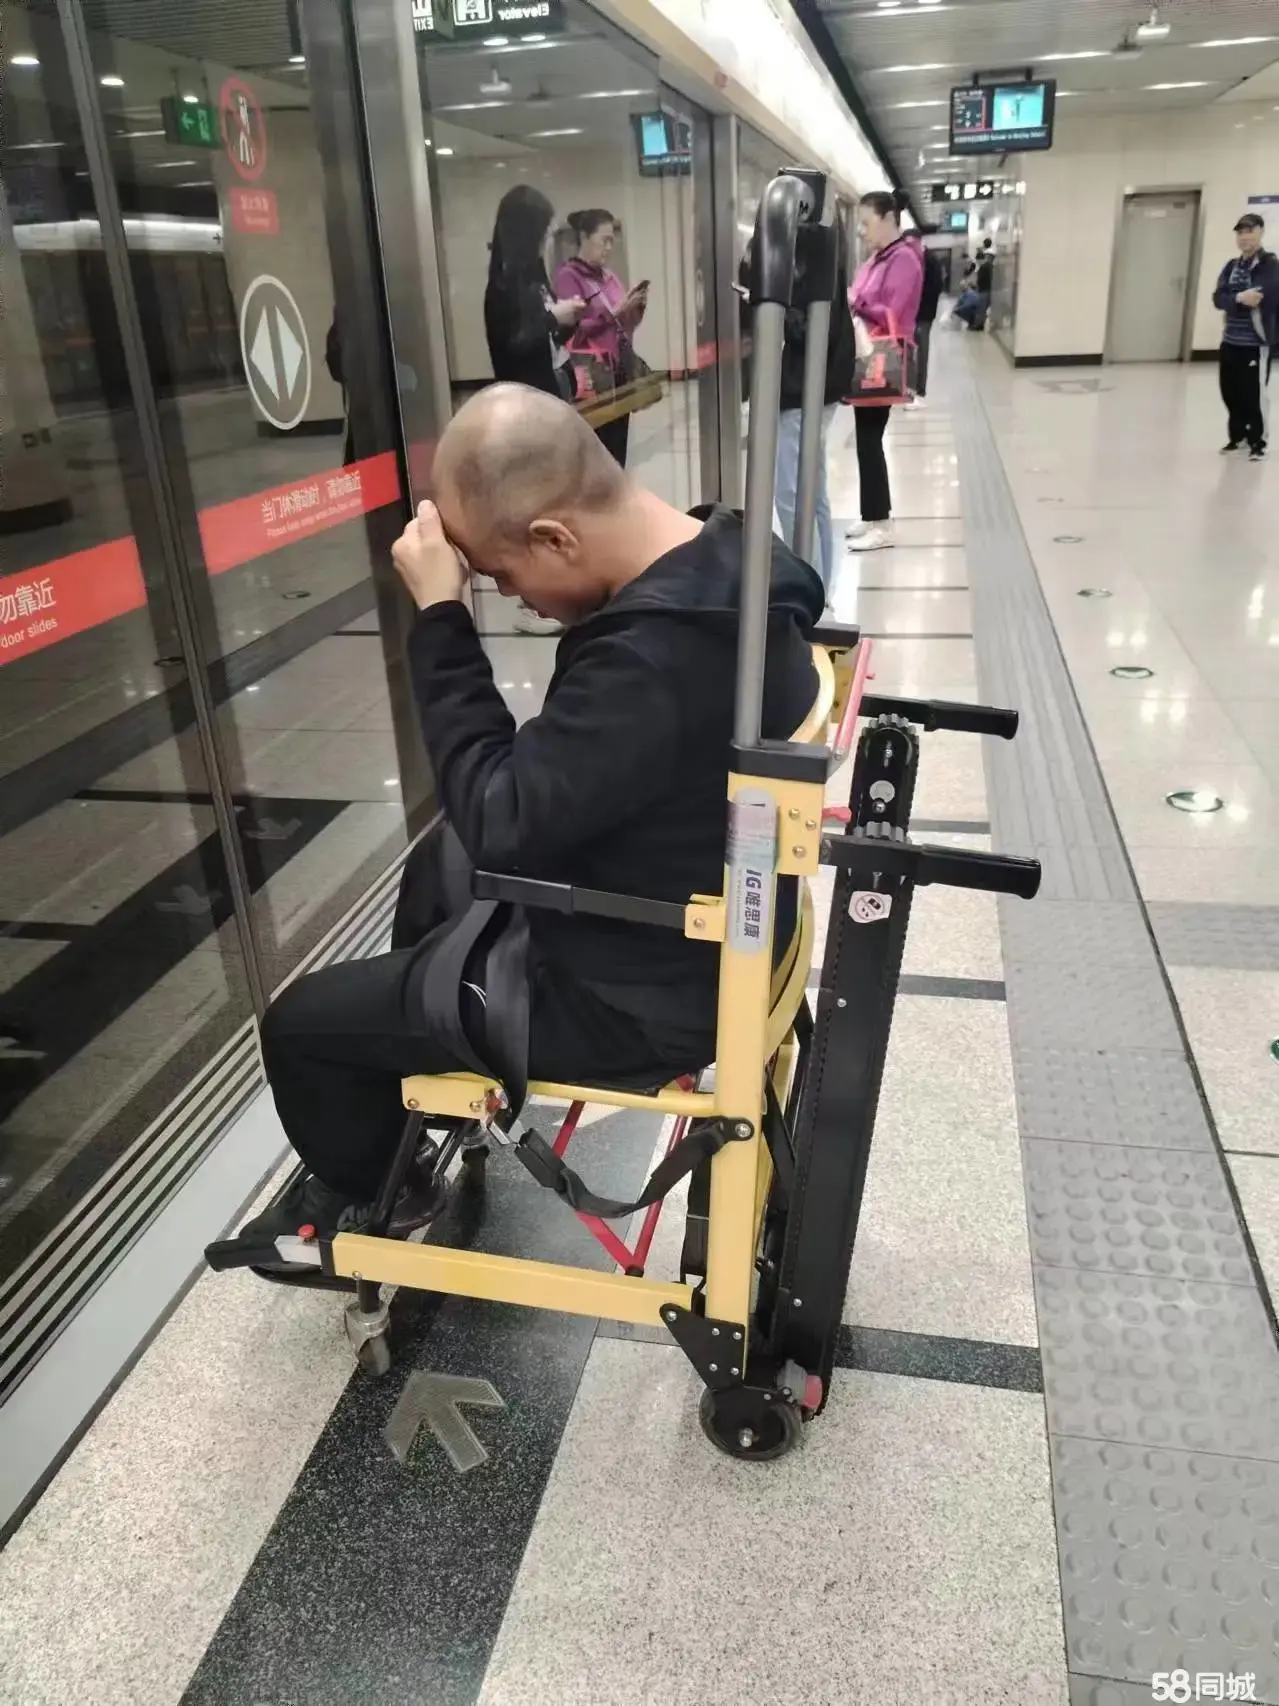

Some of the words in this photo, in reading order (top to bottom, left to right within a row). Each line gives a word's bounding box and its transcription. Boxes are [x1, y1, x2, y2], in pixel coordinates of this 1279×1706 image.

[0, 578, 56, 624] 勿靠近
[1, 631, 24, 648] door
[28, 617, 58, 637] slides
